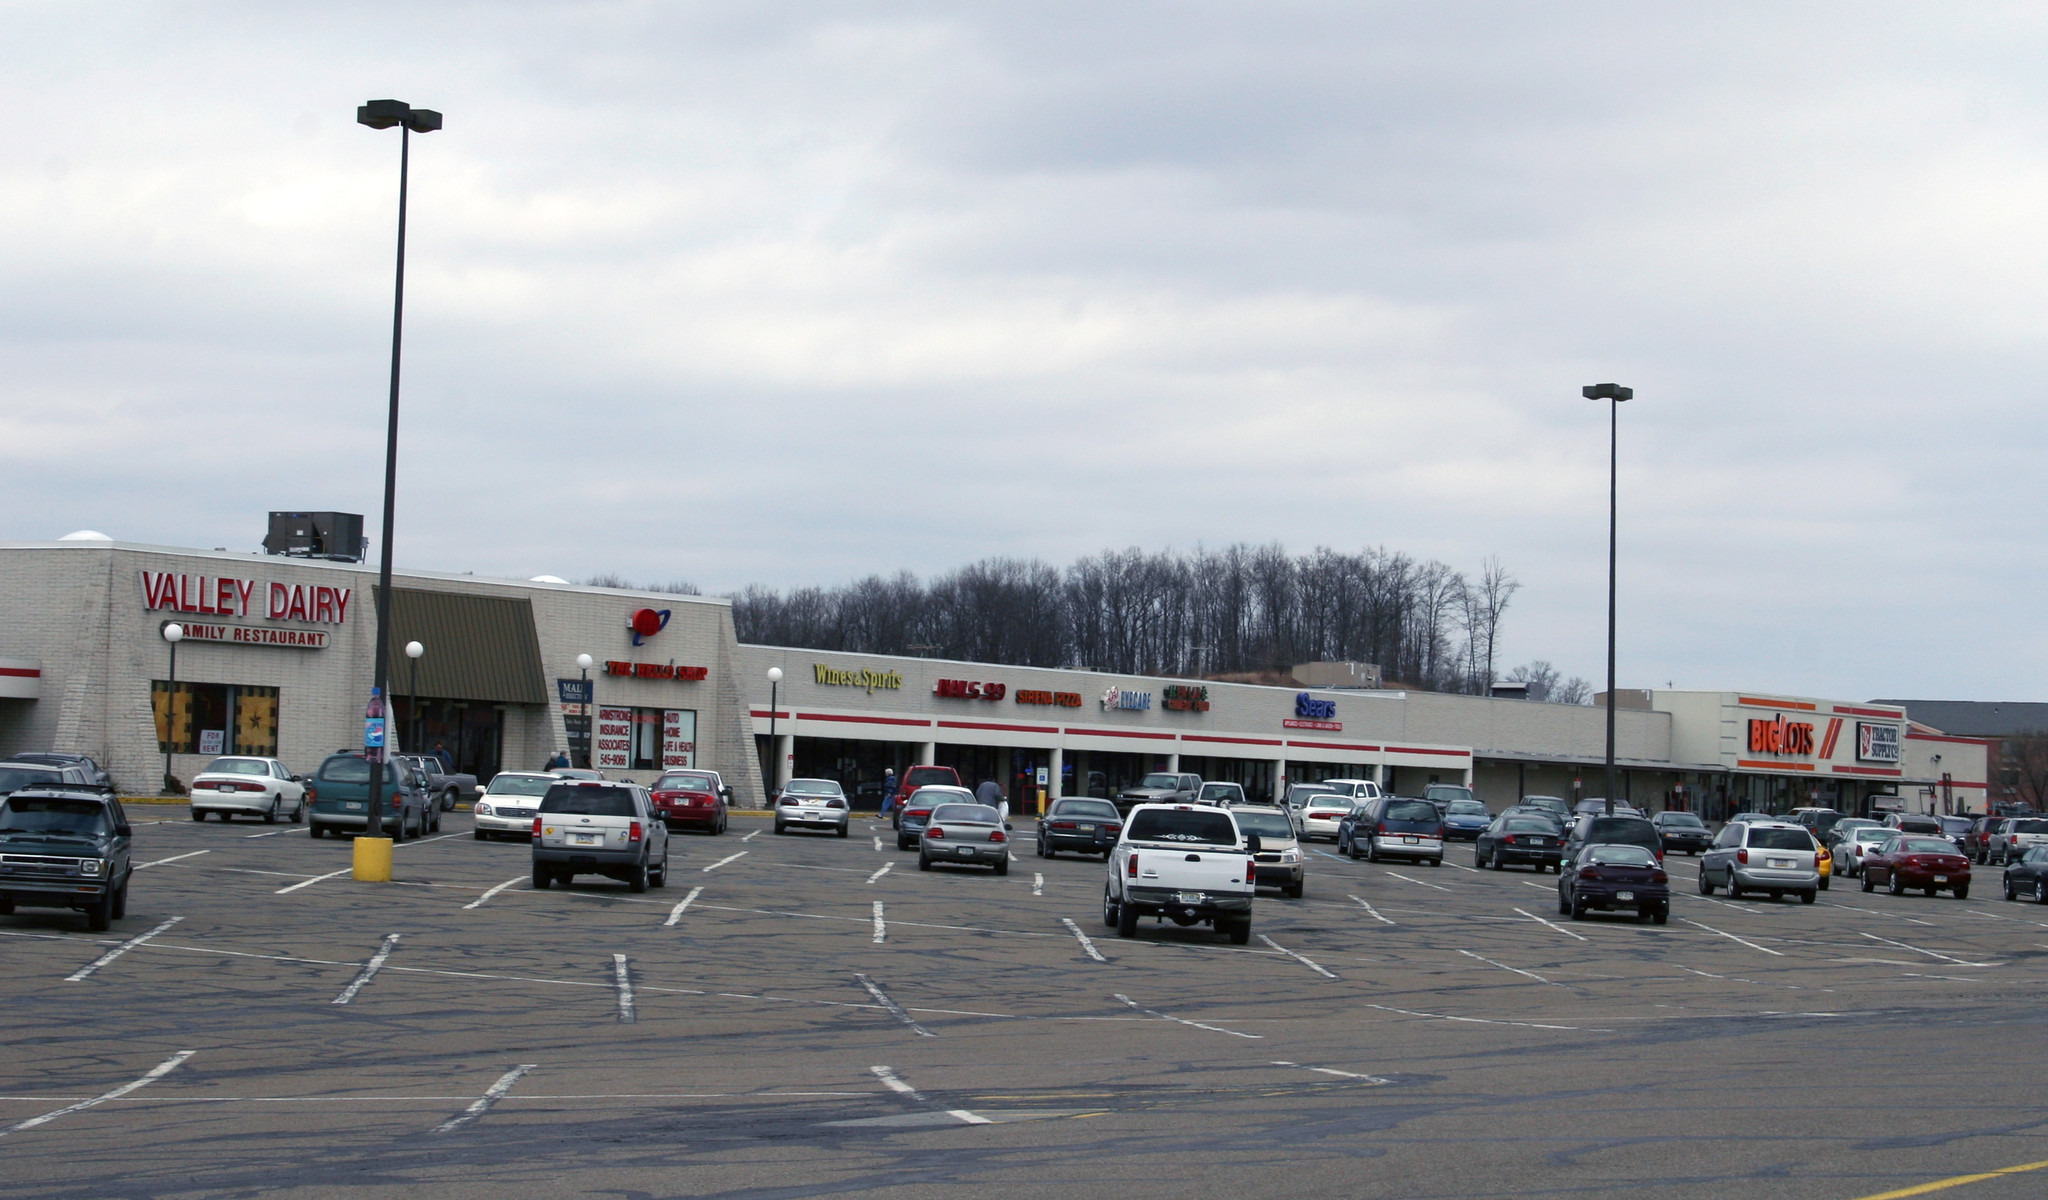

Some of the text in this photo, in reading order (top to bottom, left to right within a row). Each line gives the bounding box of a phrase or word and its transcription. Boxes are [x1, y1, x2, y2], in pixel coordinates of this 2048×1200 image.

[138, 571, 350, 623] VALLEY DAIRY
[178, 623, 325, 646] AMILY RESTAURANT
[607, 661, 632, 676] THE
[676, 667, 708, 681] SHOP
[814, 664, 853, 685] Wines
[861, 667, 902, 694] Spirits
[563, 683, 584, 693] MAL
[1016, 690, 1083, 707] SIRENA PIZZA
[1120, 691, 1151, 710] EYECARE
[1296, 692, 1336, 718] Sears
[599, 709, 631, 721] ARMSTRONG
[599, 724, 629, 736] INSURANCE
[1783, 722, 1814, 754] LOTS
[1871, 726, 1897, 743] TRACTOR
[598, 739, 630, 751] ASSOCIATES
[1871, 743, 1891, 758] SUPPLY
[600, 754, 627, 766] 545-9066
